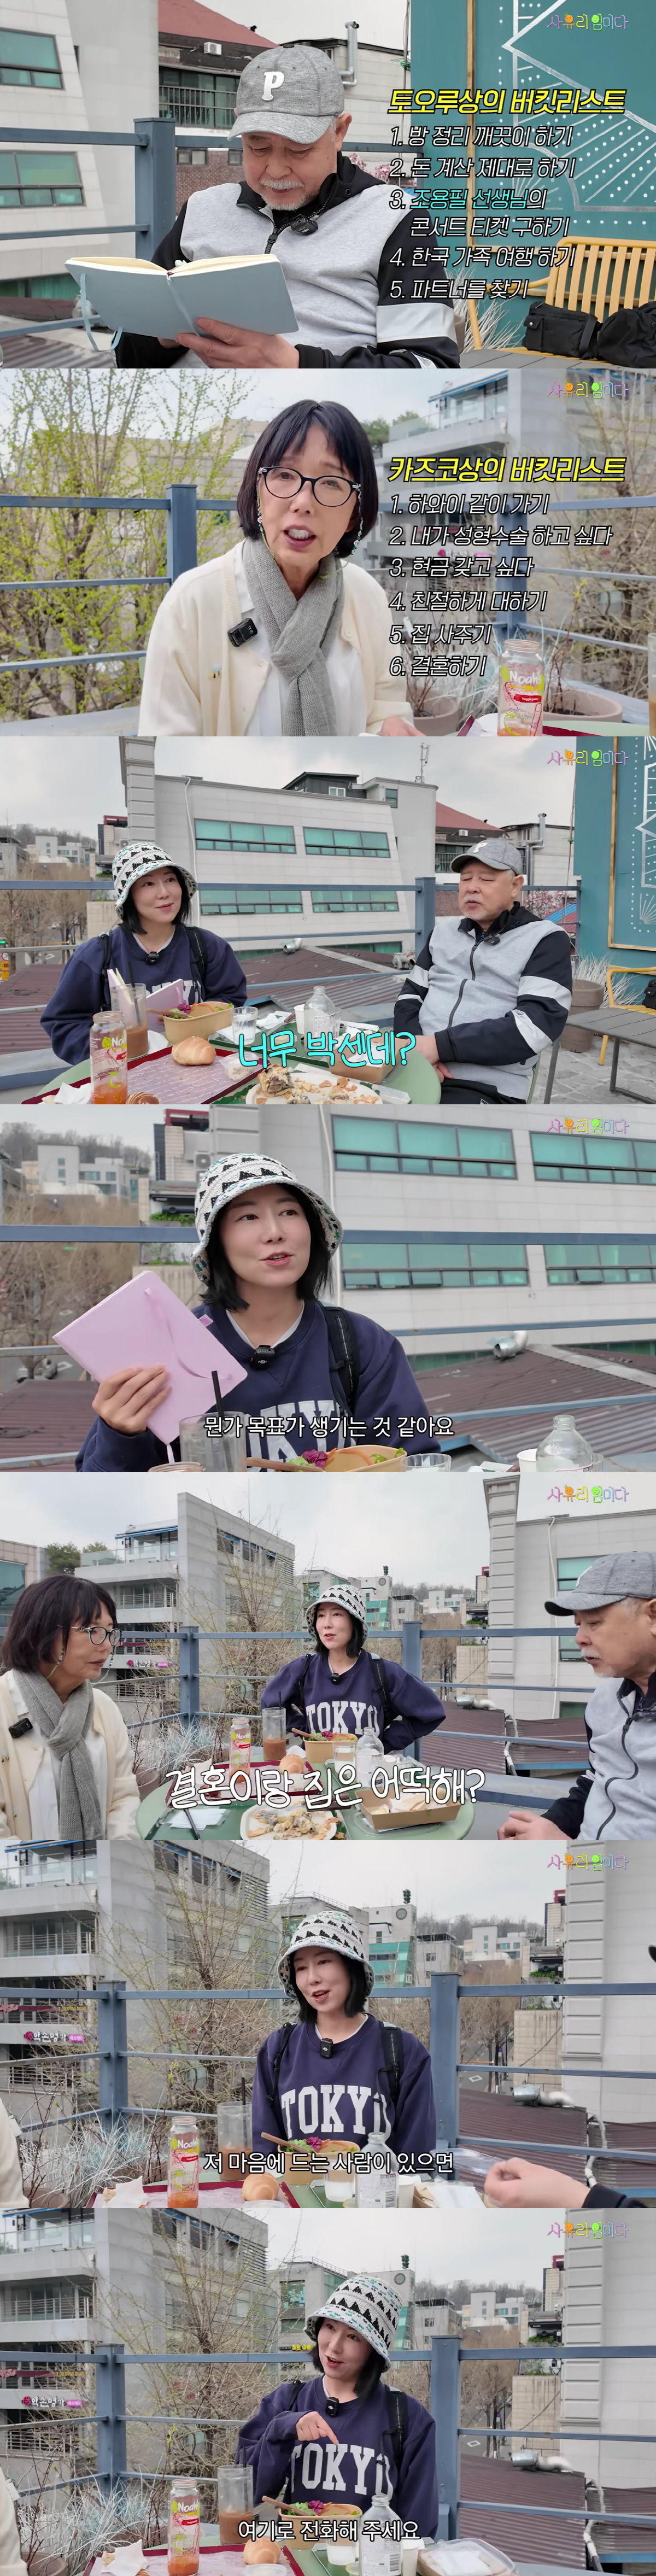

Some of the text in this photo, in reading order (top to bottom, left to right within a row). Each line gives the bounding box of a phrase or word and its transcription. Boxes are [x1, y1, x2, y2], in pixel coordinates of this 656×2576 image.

[261, 71, 285, 101] P
[509, 670, 542, 684] Noah's
[473, 842, 488, 853] P
[306, 1701, 380, 1737] TOKYO
[281, 2085, 391, 2142] TOKYO
